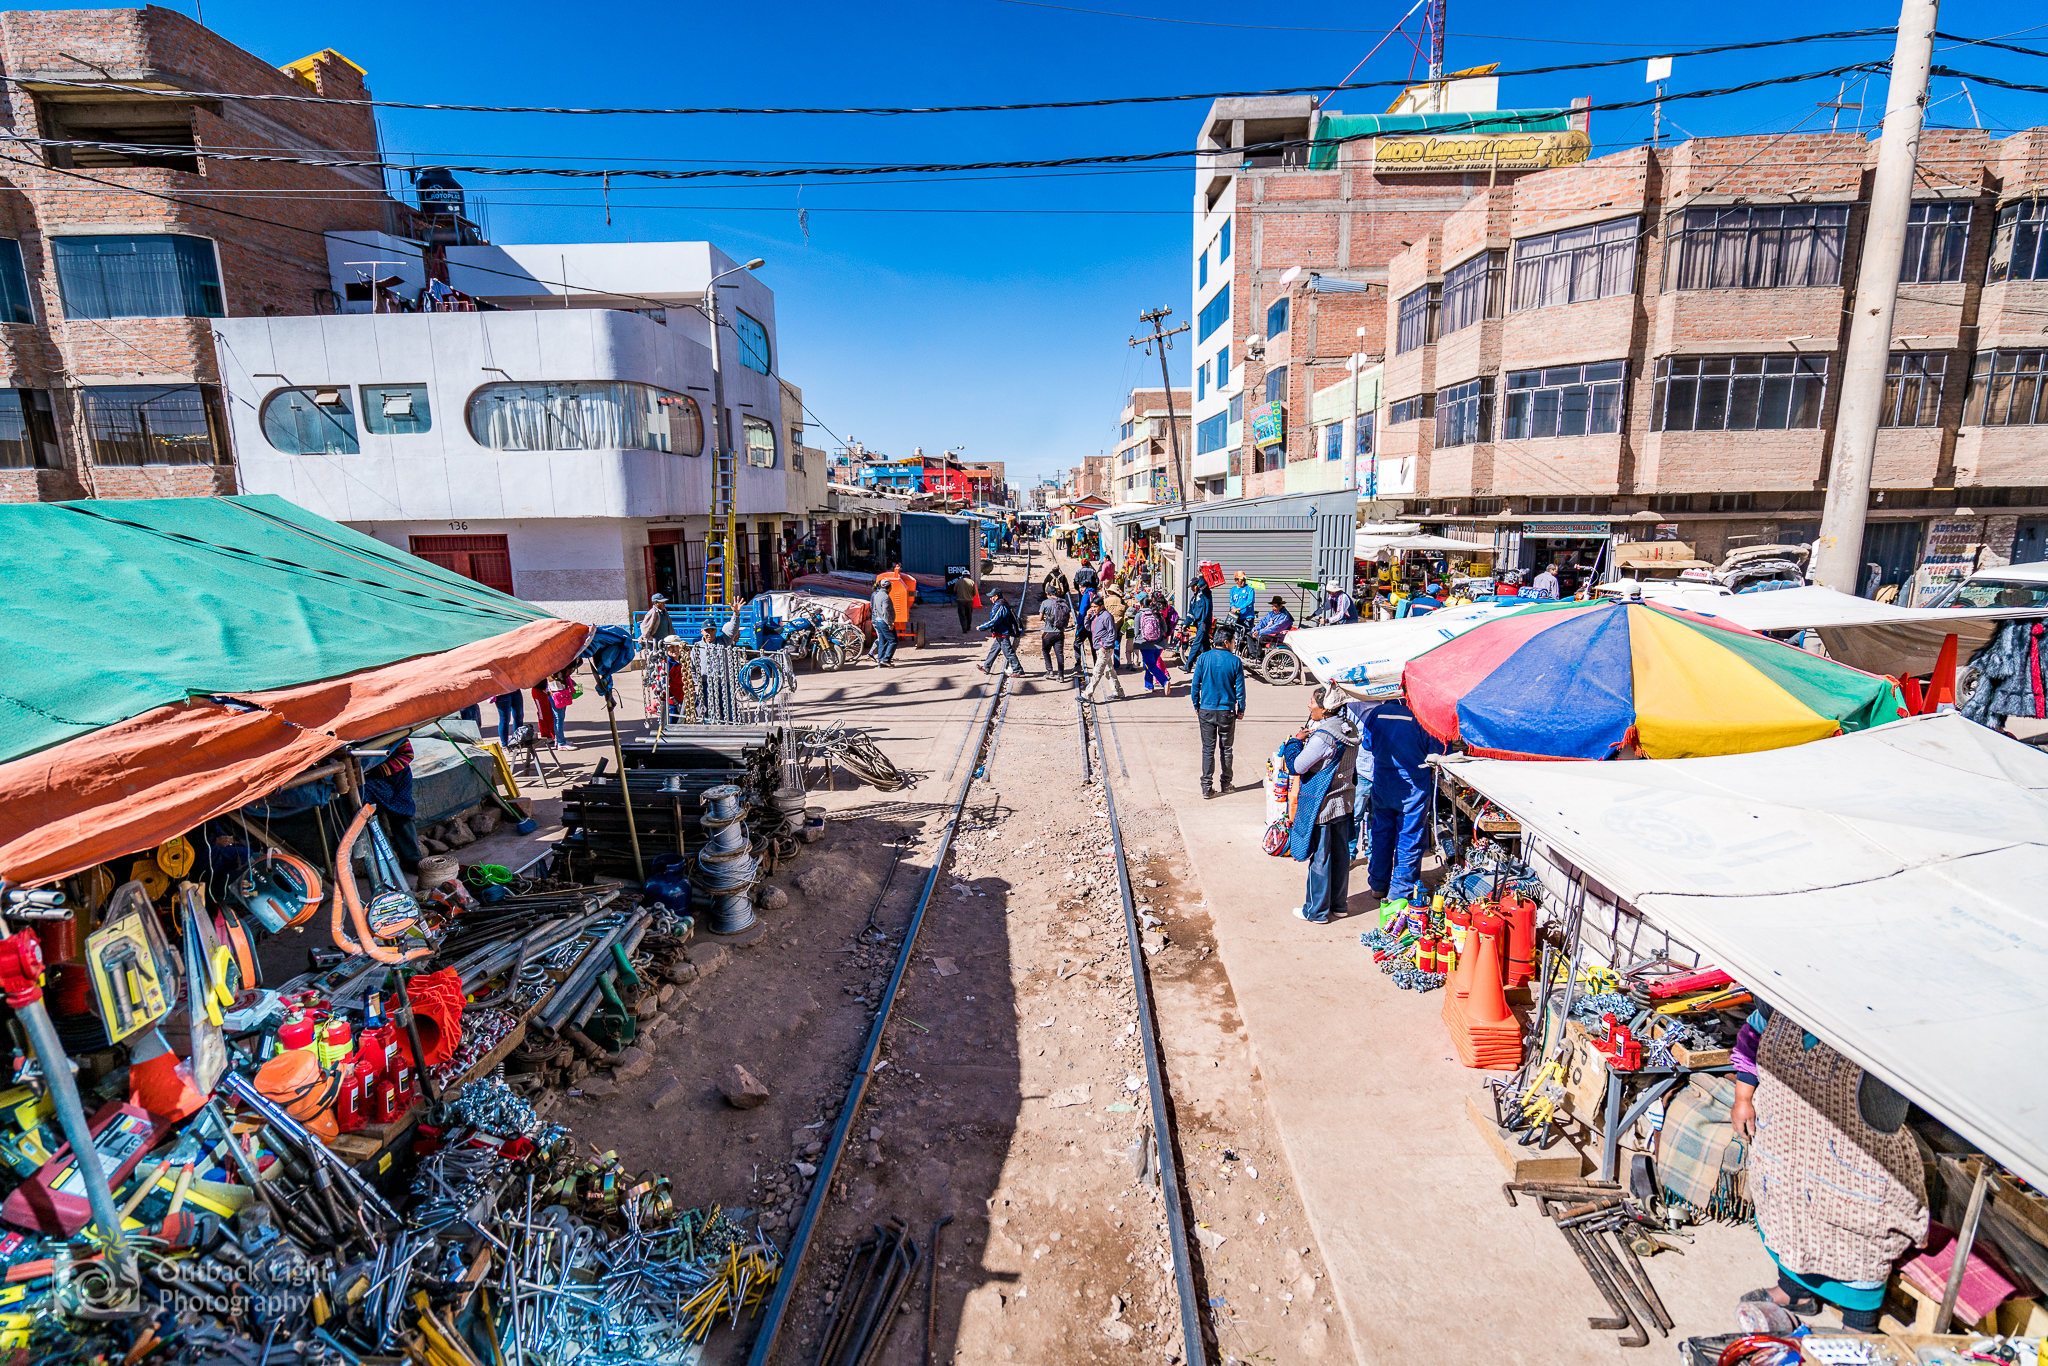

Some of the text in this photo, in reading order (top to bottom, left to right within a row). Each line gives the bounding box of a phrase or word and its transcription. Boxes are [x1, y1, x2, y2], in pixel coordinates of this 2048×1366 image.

[1376, 141, 1424, 162] MOTO
[1425, 138, 1488, 162] IMPORT
[1271, 400, 1282, 438] COLCA
[449, 521, 468, 531] 136
